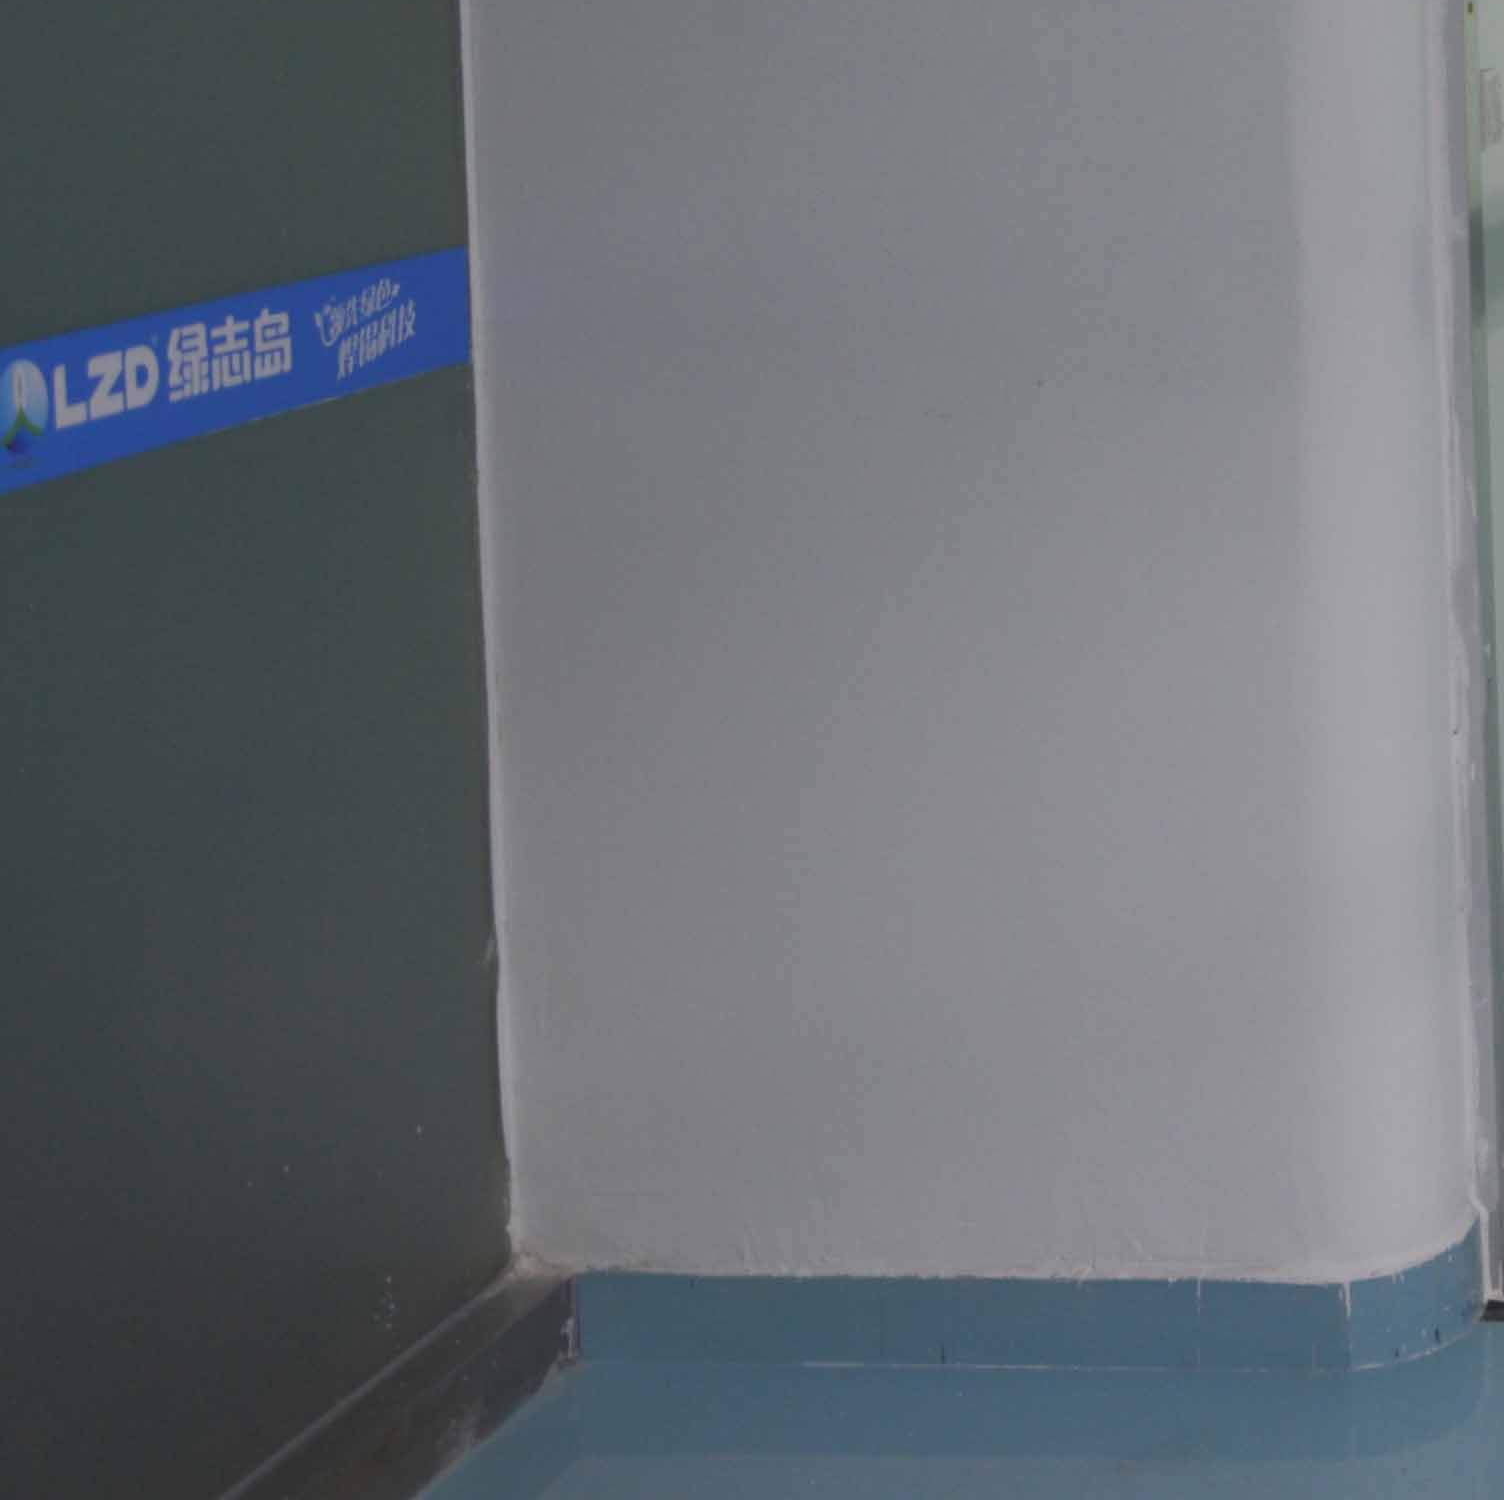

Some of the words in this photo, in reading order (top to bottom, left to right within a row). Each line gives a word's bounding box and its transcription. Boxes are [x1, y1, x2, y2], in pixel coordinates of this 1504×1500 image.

[53, 343, 160, 430] LZD
[167, 308, 293, 403] 绿志岛
